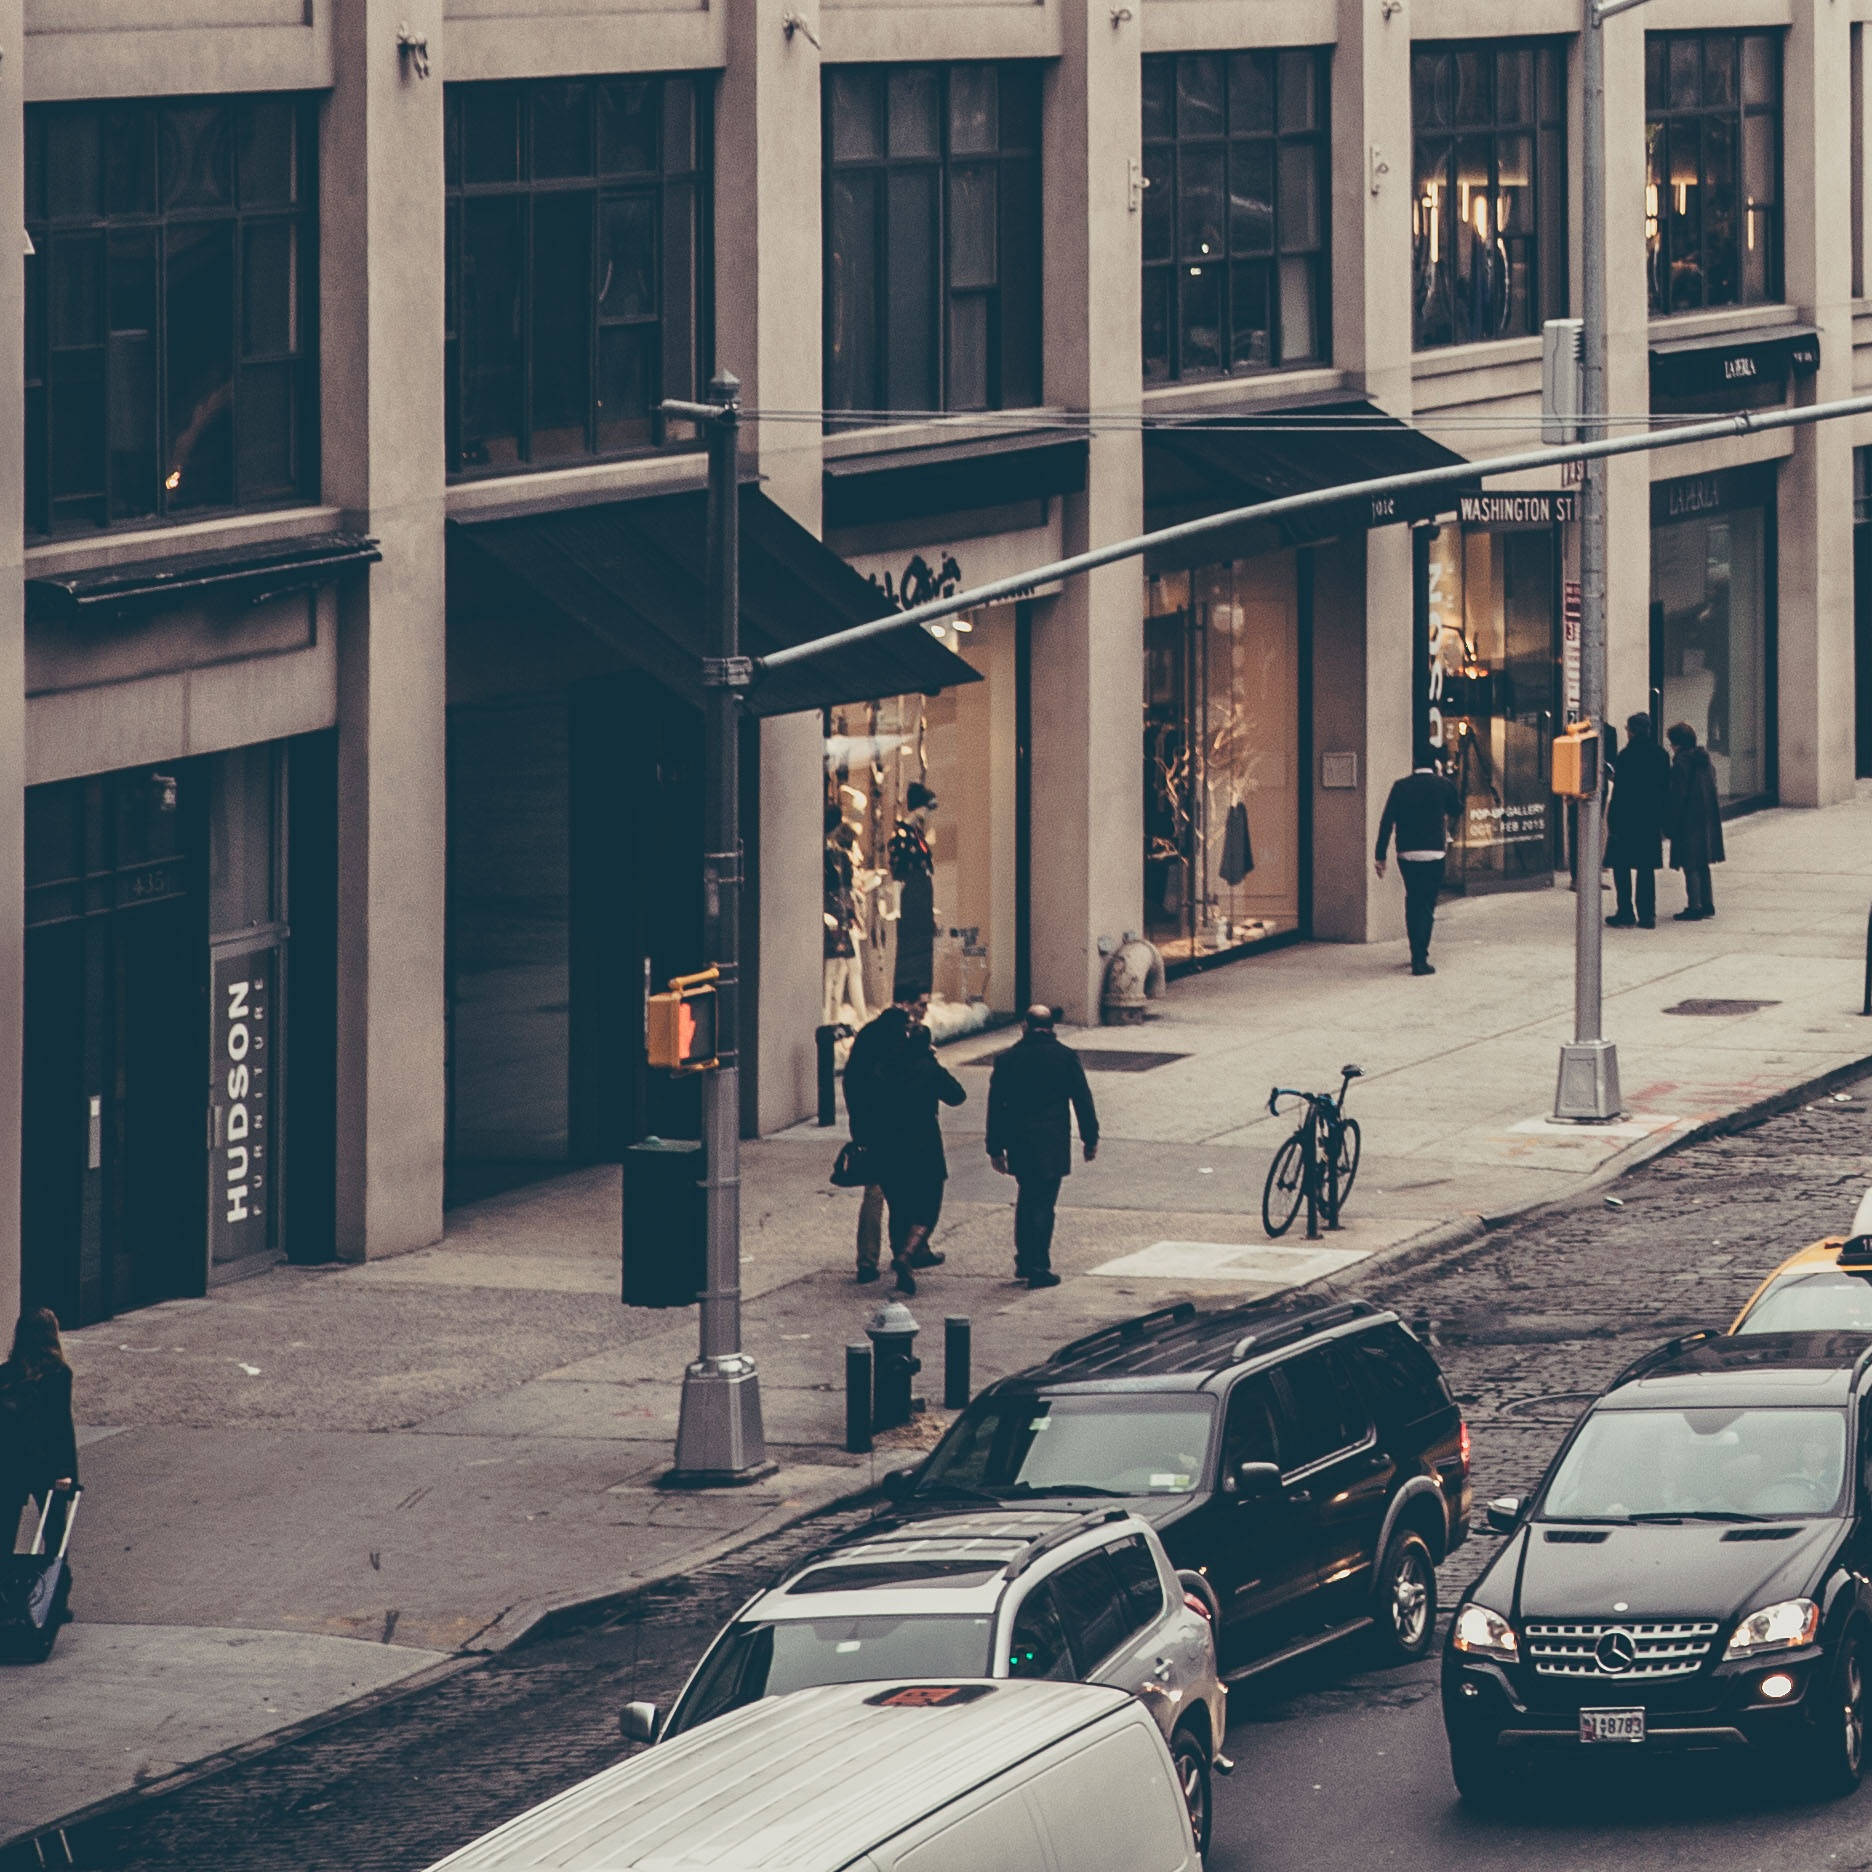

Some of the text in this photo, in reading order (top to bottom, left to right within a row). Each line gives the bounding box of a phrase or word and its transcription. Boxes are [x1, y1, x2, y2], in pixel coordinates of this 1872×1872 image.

[1460, 498, 1572, 522] WASHINGTON ST
[227, 981, 249, 1223] HUDSON
[253, 978, 264, 1216] FURNITURE
